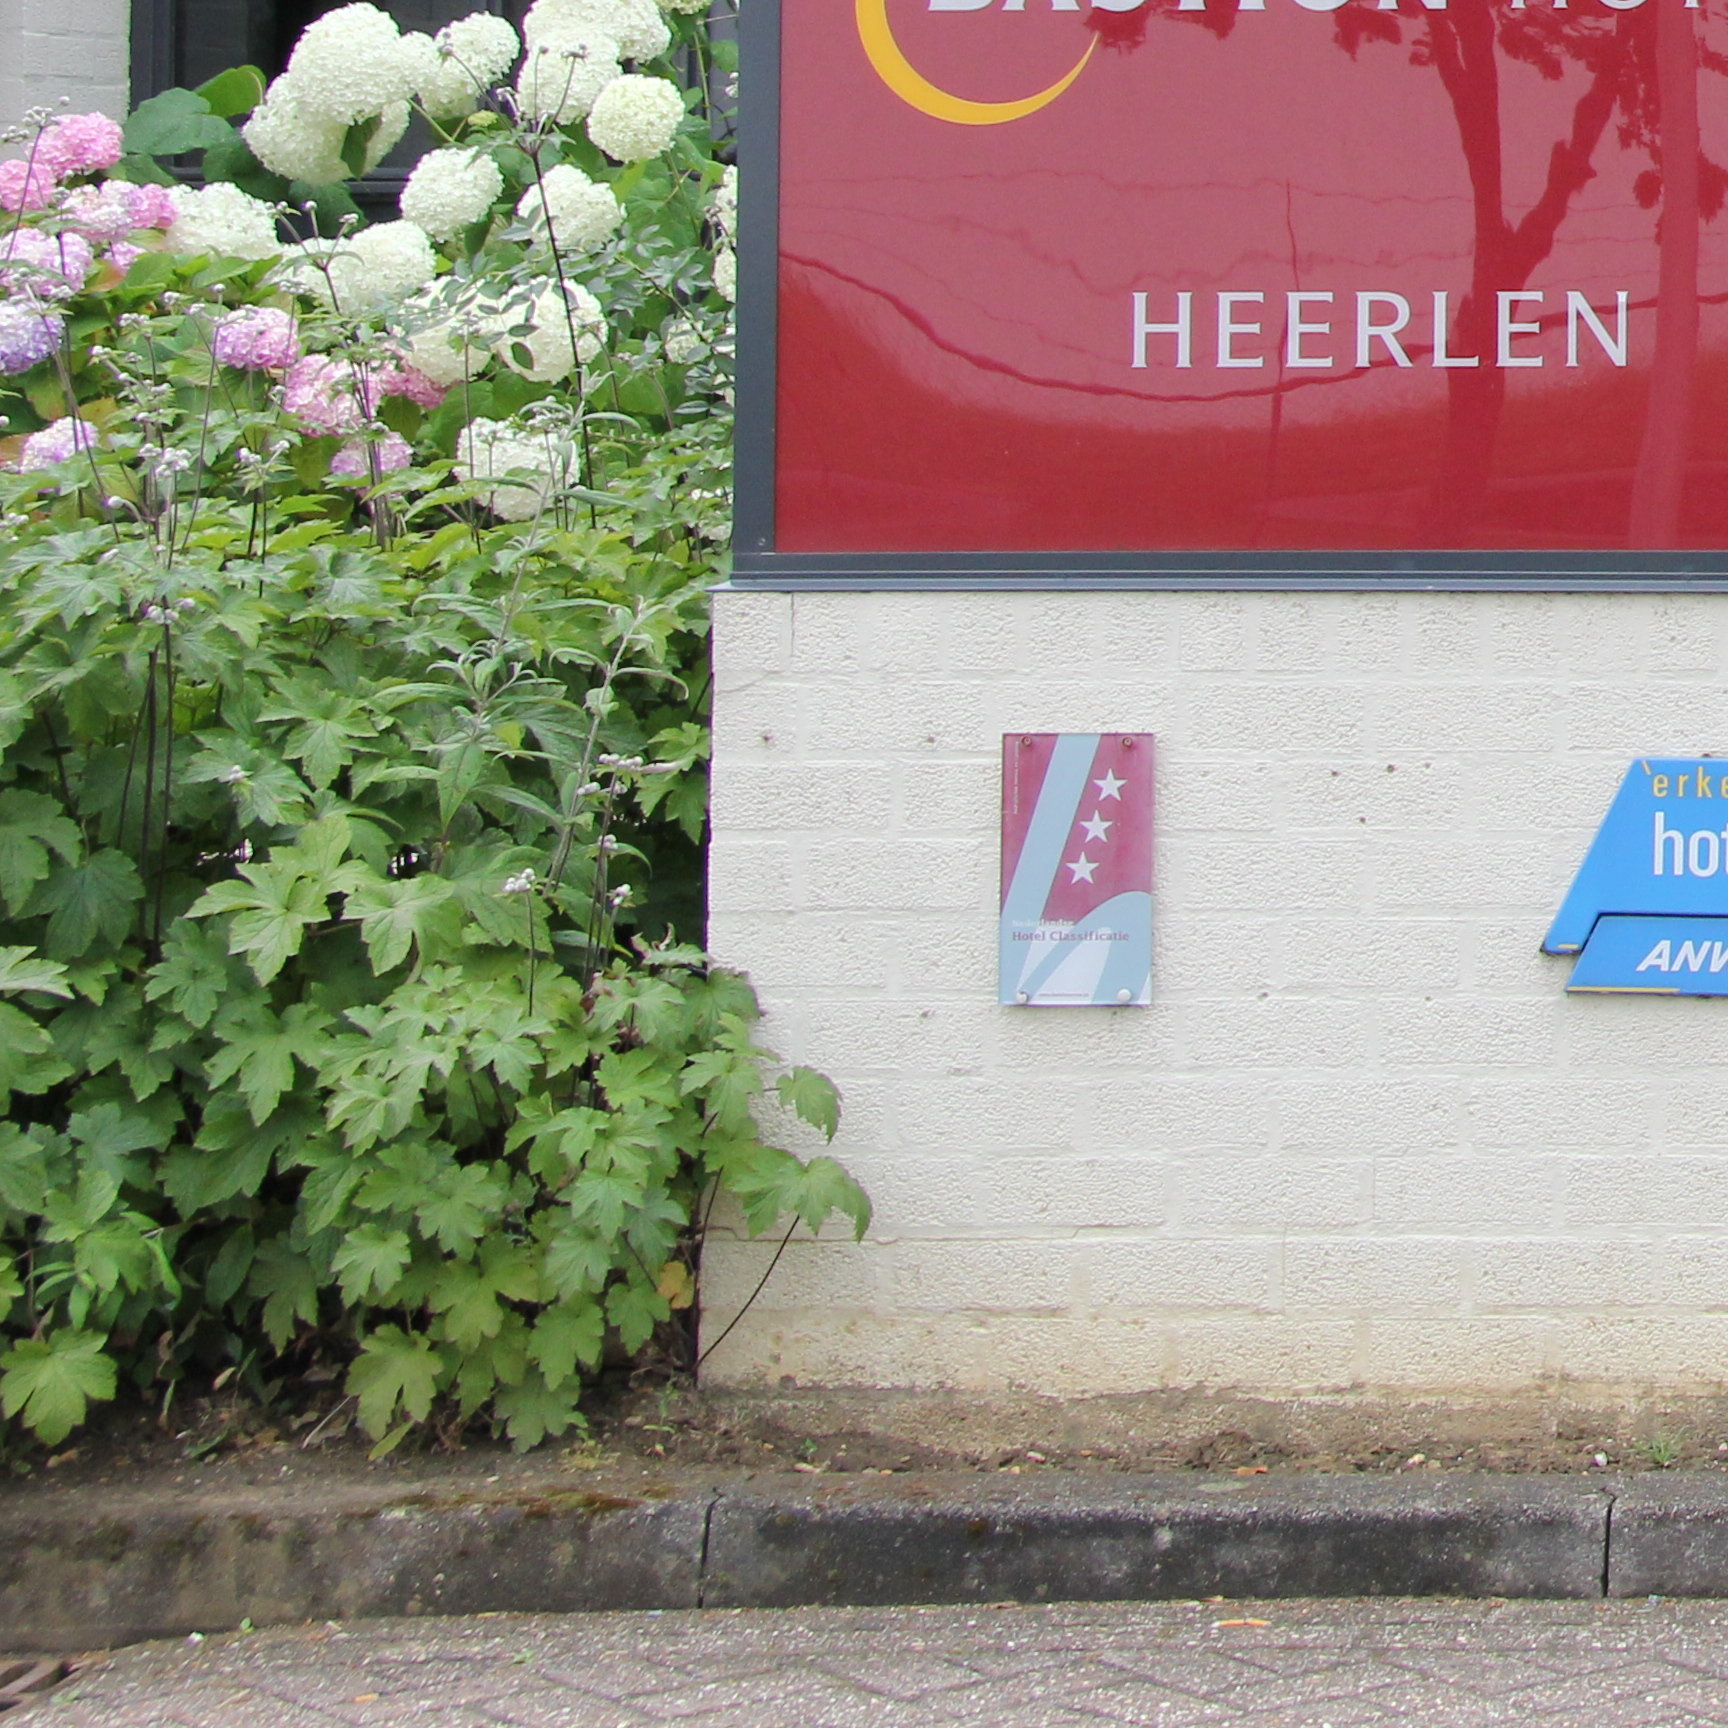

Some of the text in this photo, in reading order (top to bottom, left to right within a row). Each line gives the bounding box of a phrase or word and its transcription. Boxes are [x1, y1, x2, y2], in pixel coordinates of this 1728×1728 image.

[1131, 289, 1631, 368] HEERLEN
[1012, 930, 1130, 941] Hotel Classificatie
